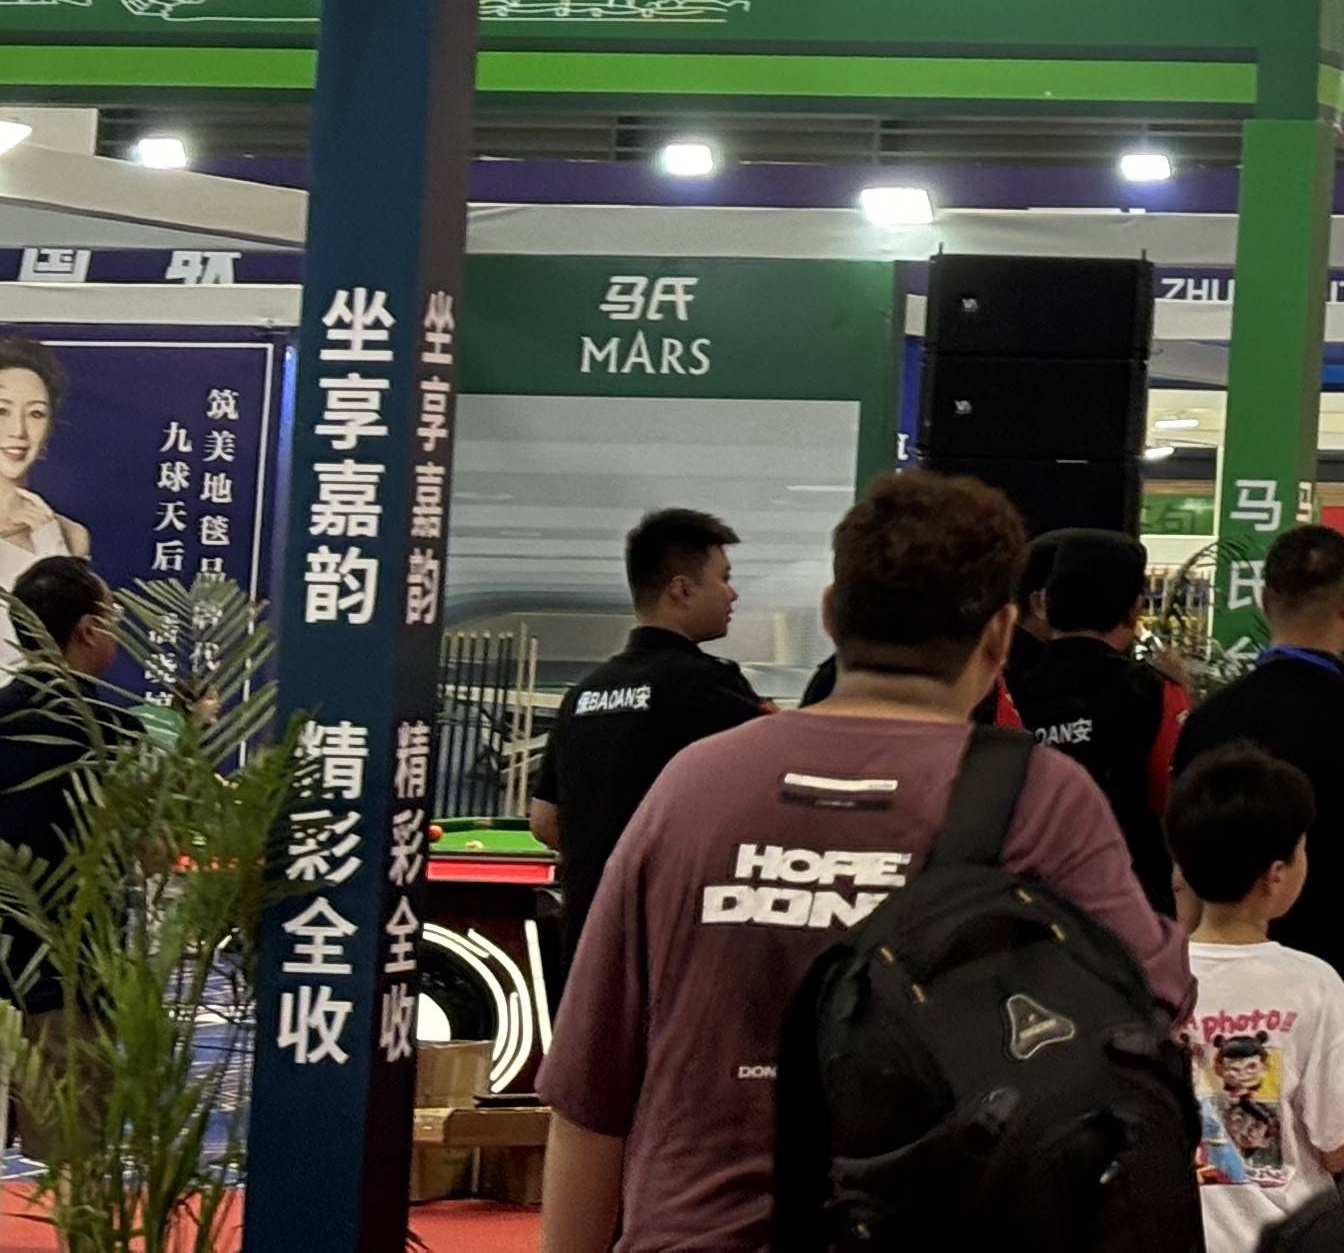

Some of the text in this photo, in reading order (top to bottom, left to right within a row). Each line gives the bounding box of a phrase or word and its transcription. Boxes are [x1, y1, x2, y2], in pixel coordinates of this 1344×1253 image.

[304, 287, 397, 626] 坐享嘉韵
[405, 289, 456, 626] 坐享嘉韵
[579, 329, 712, 376] MARS
[151, 420, 194, 572] 九球天后
[276, 719, 370, 1066] 精彩全收
[379, 719, 432, 1064] 精彩全收
[701, 885, 891, 928] DON
[734, 843, 913, 887] HOPE
